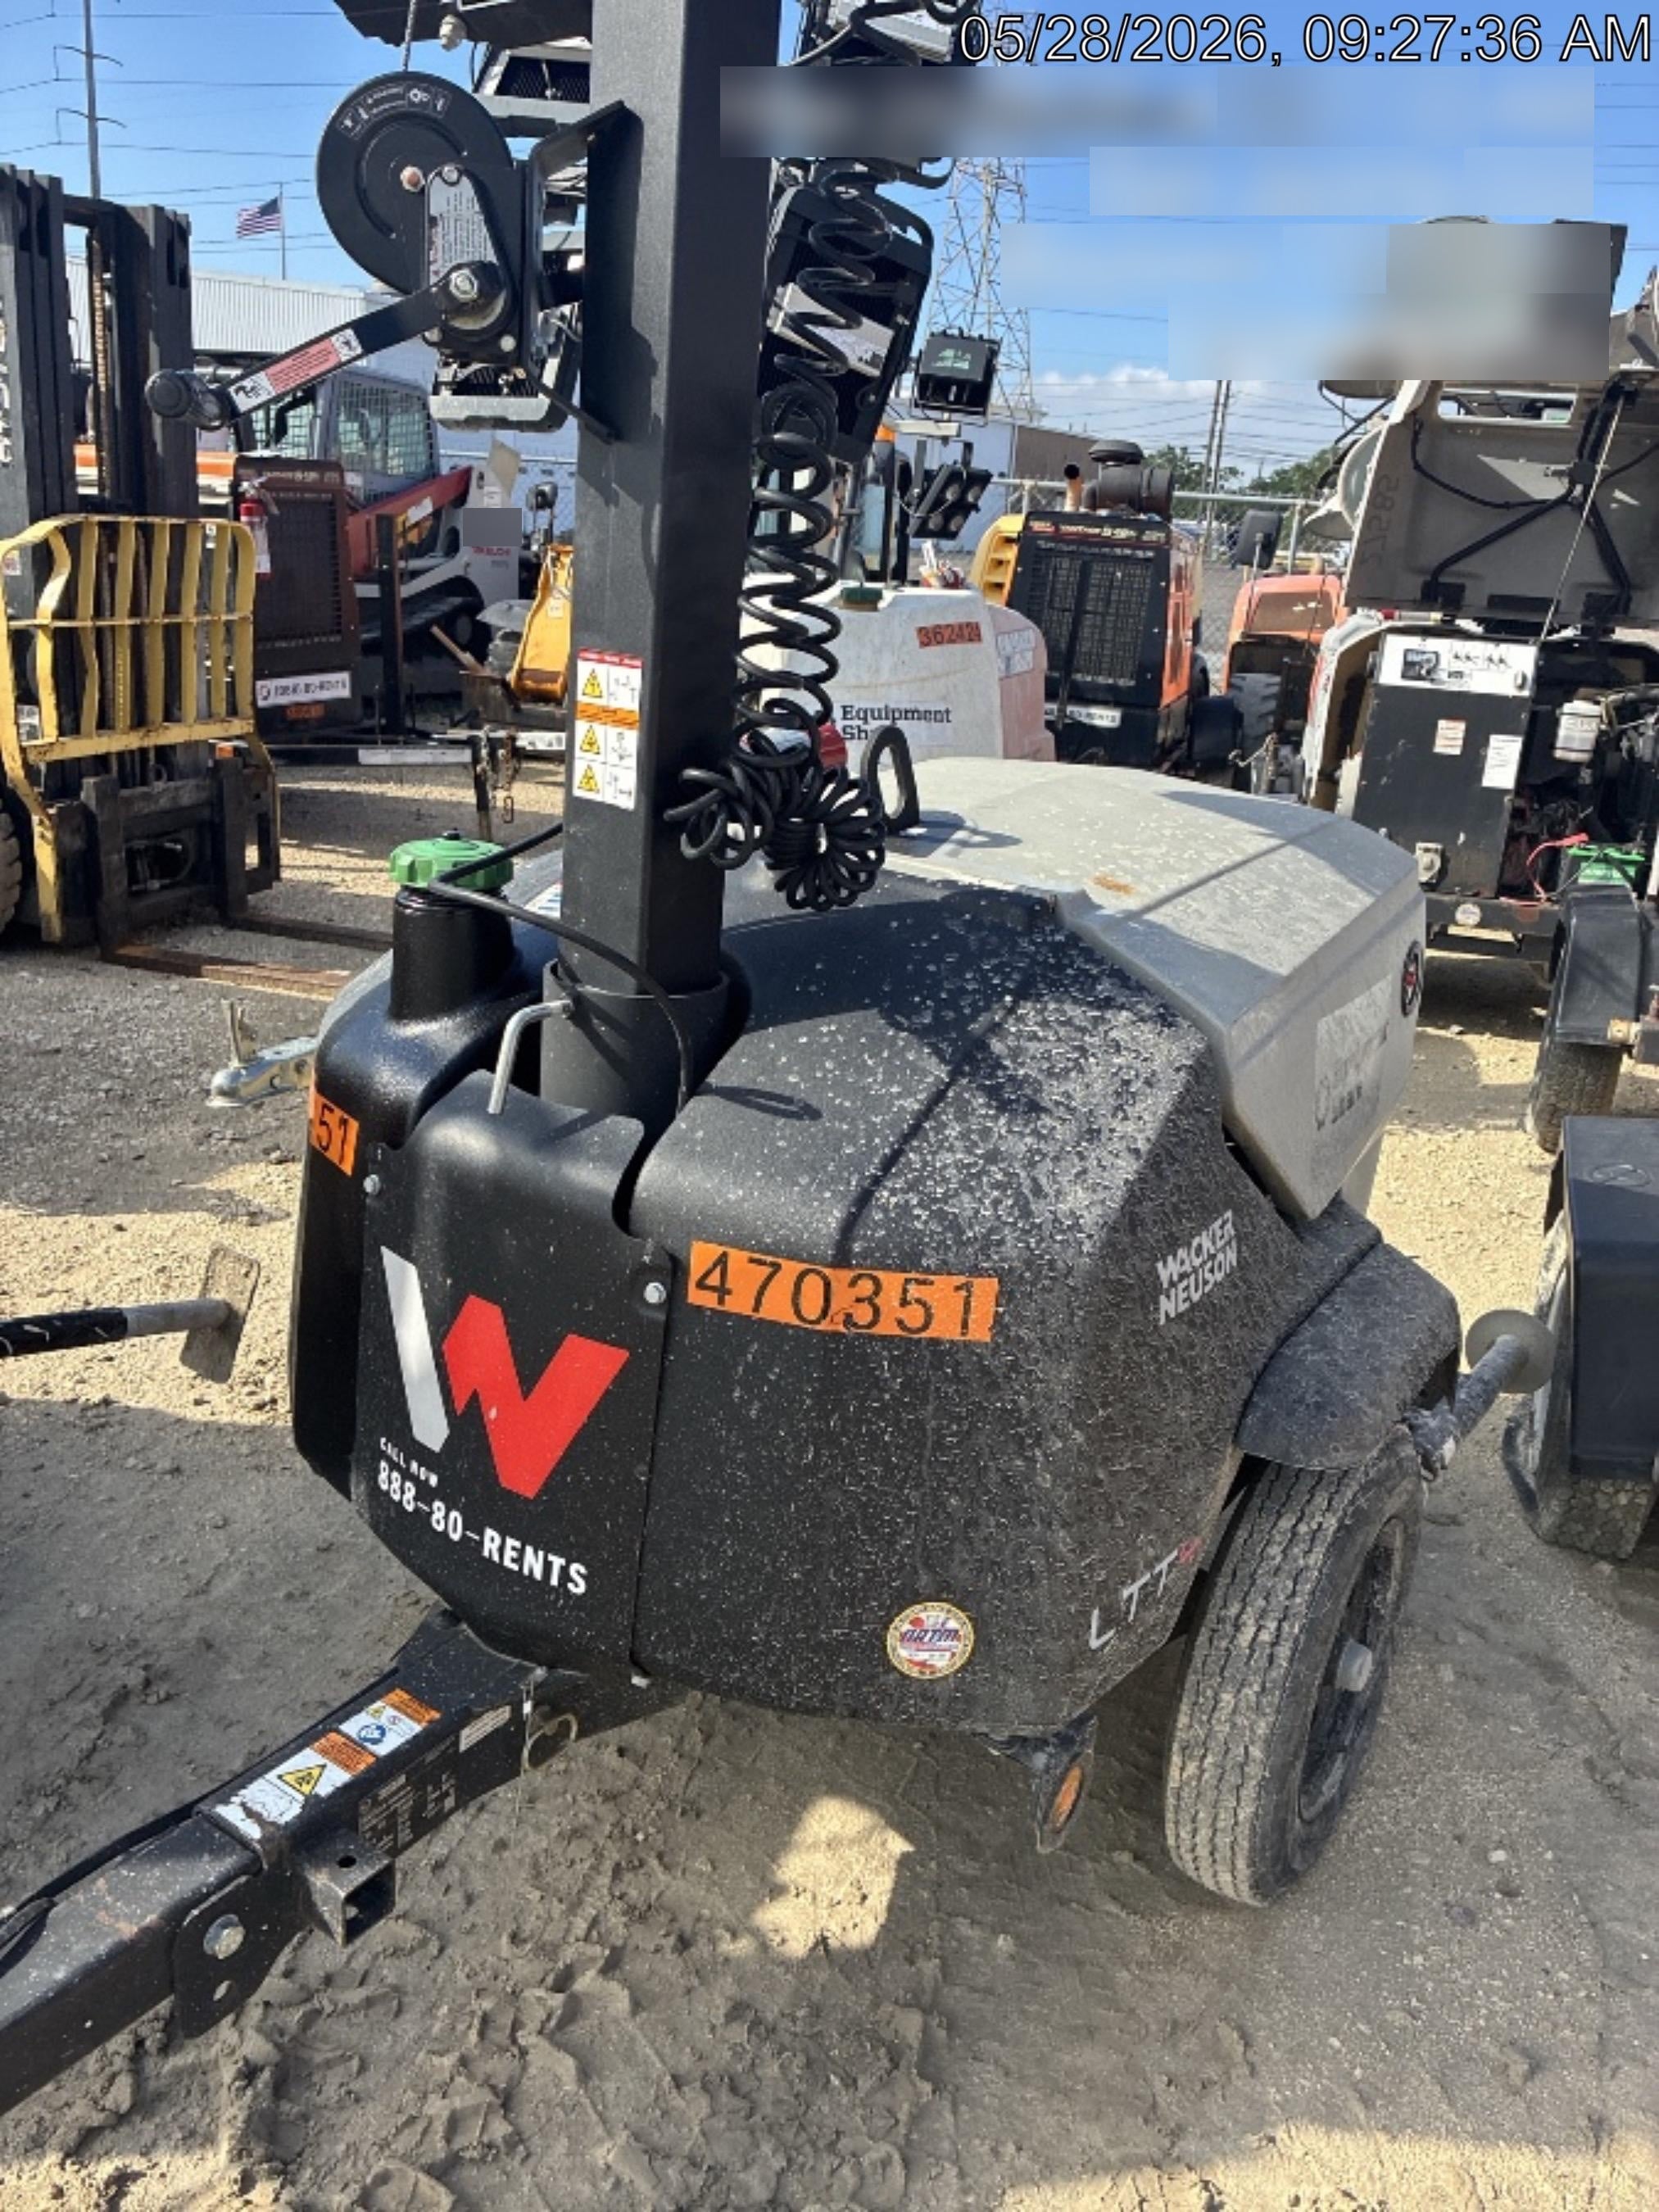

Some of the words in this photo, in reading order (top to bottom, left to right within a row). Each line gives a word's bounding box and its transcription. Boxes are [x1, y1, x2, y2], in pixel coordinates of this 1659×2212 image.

[840, 704, 953, 725] Equipment
[309, 1103, 350, 1166] 51
[1155, 1208, 1236, 1289] WACKER
[1159, 1238, 1237, 1326] NEUSON
[693, 1250, 975, 1338] 470351
[377, 1459, 588, 1596] 888-80-RENTS
